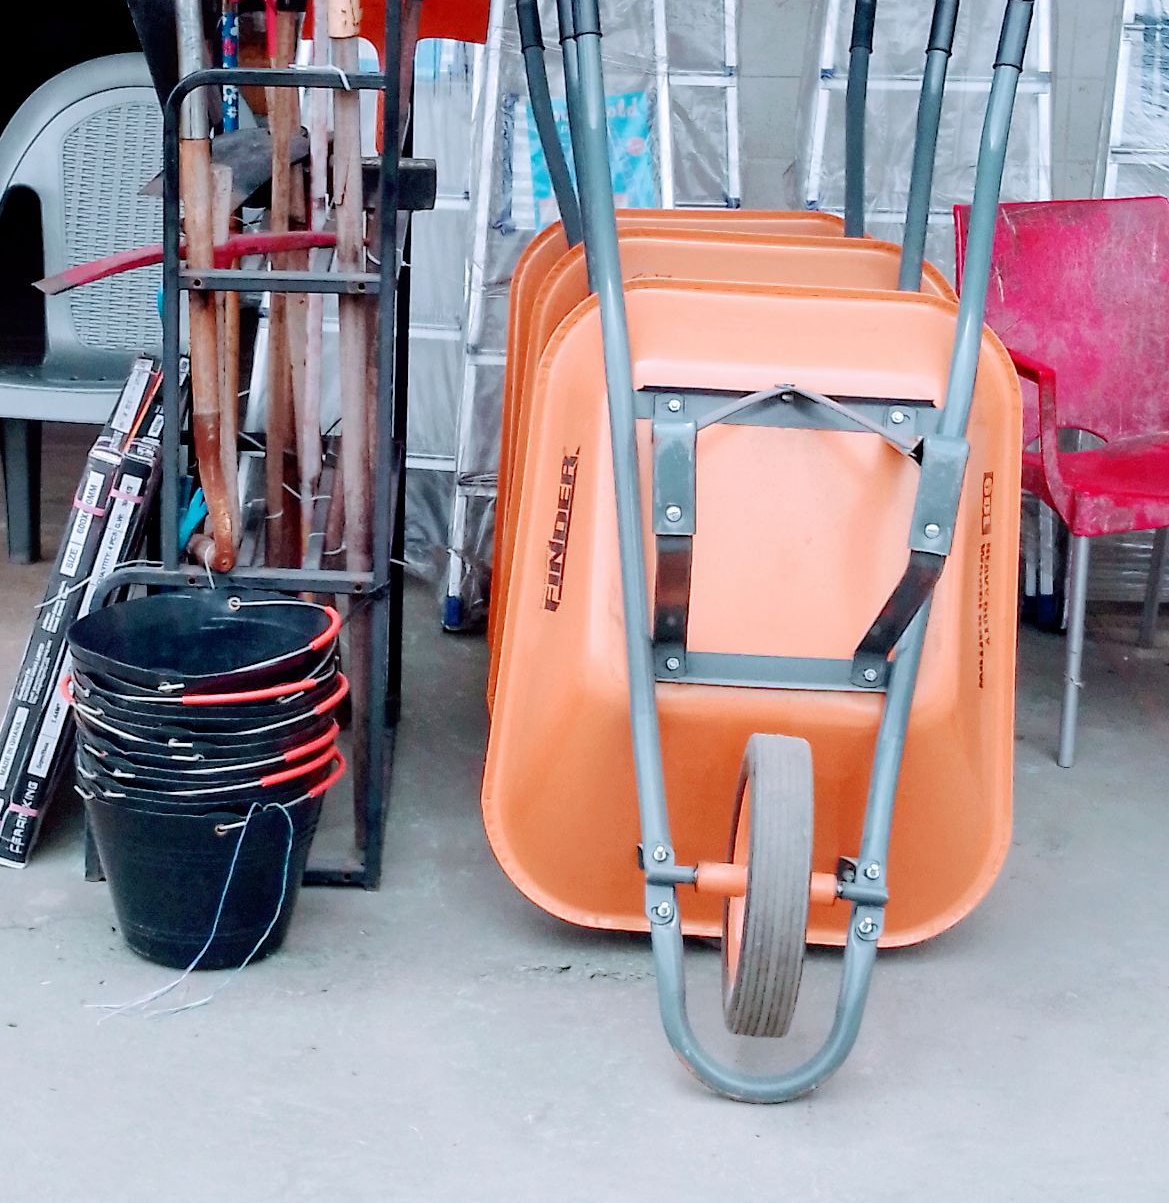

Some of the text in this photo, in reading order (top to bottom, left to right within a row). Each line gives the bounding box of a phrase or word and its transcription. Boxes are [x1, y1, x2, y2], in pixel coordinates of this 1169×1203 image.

[65, 484, 98, 569] SIZE 600X0MM
[543, 453, 579, 612] FINDER
[0, 756, 12, 777] MADE
[10, 720, 23, 747] GHANA
